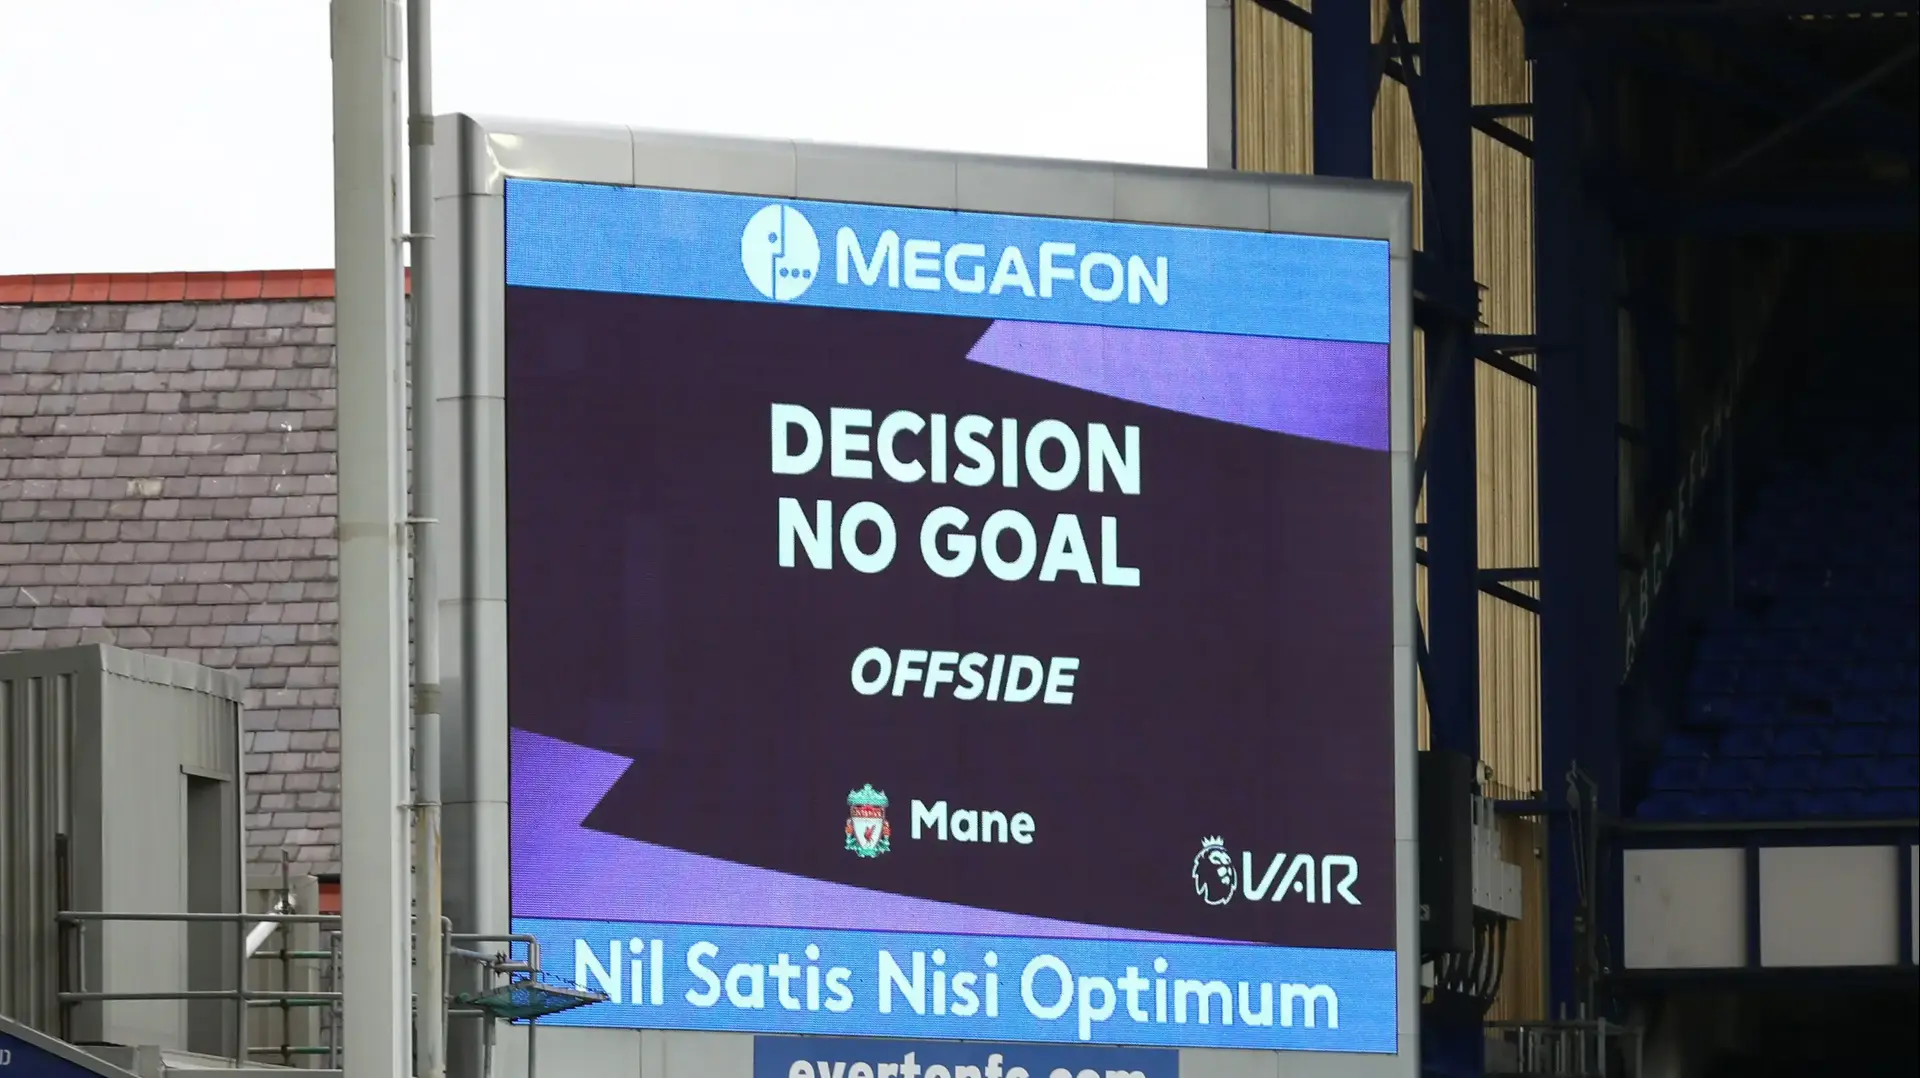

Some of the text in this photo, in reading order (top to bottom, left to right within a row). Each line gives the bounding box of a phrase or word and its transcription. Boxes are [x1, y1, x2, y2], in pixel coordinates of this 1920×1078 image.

[771, 402, 1142, 496] DECISION
[778, 497, 1142, 588] NO GOAL
[851, 646, 1081, 706] OFFSIDE
[911, 799, 1037, 845] Mane
[1243, 851, 1363, 906] VAR
[575, 937, 1339, 1042] Nil Satis Nisi Optimum
